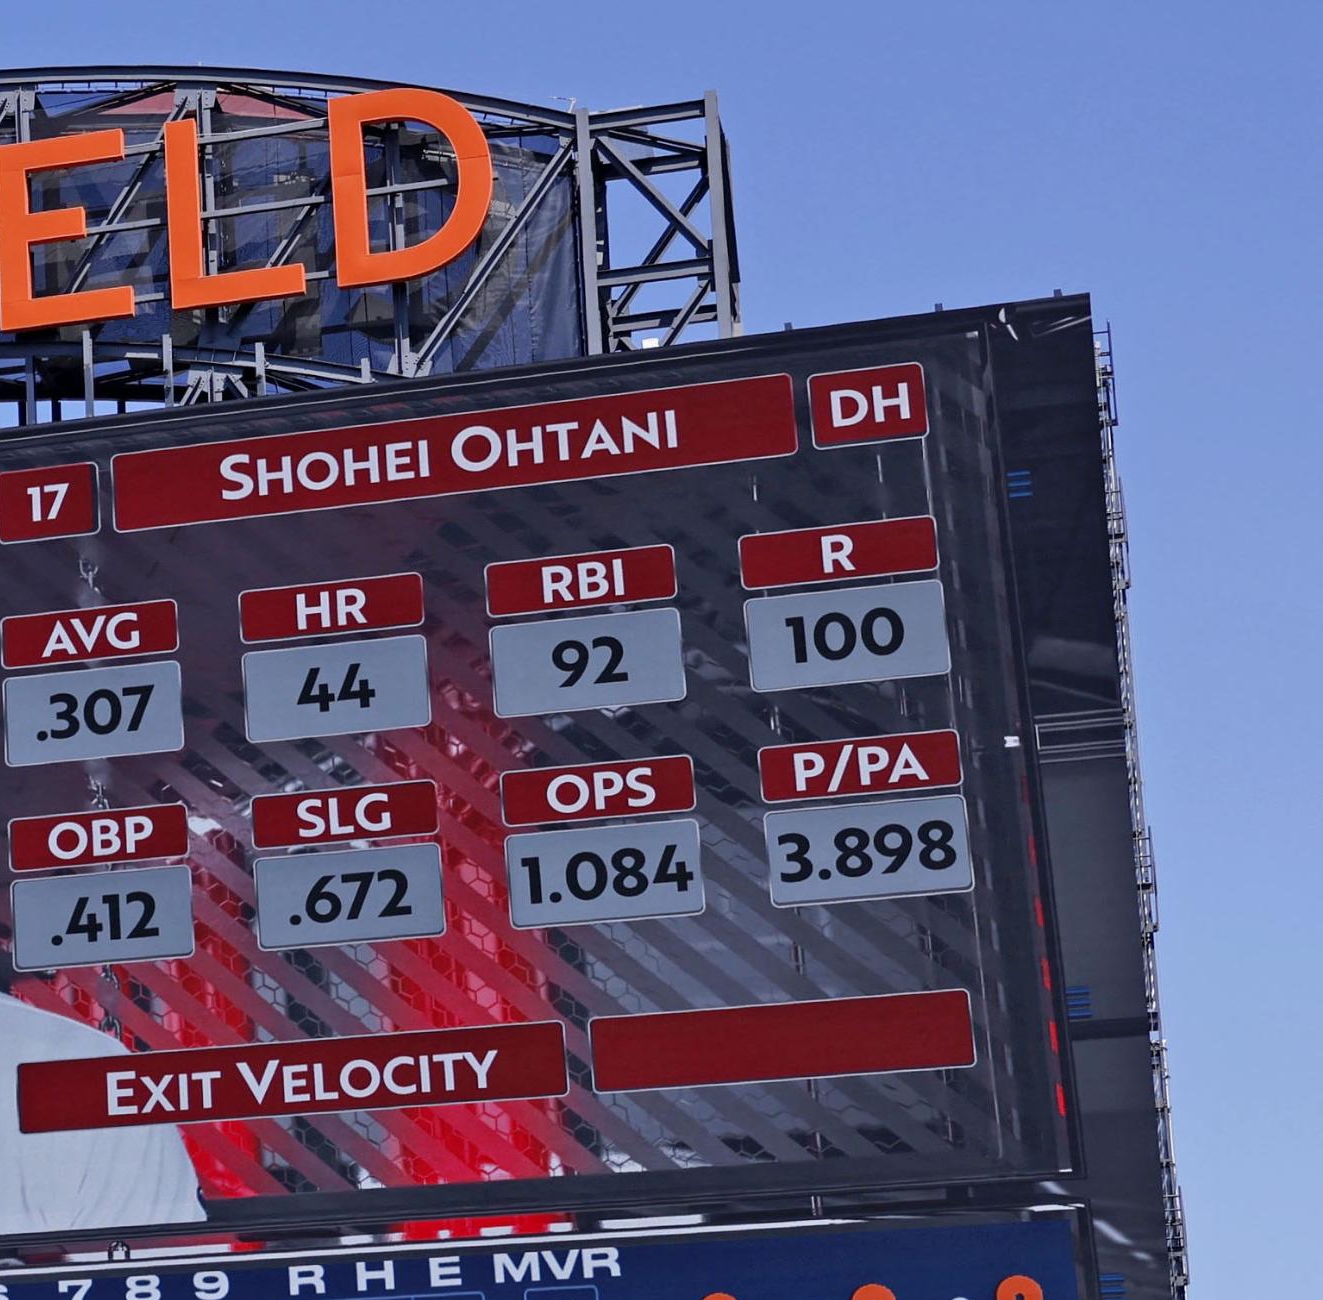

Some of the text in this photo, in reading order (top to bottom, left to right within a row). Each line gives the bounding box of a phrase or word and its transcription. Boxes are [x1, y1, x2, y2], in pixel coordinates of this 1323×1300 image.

[26, 382, 912, 522] 17 SHOHEI OHTANI DH
[41, 534, 855, 657] AVG HR RBI R
[34, 606, 905, 744] .307 44 92 100
[46, 745, 930, 858] OBP SLG OPS P/PA
[49, 818, 958, 946] .412 .672 1.084 3.898
[105, 1047, 499, 1116] EXIT VELOCITY
[288, 1264, 327, 1296] R
[357, 1260, 396, 1292] H
[429, 1256, 463, 1288] E
[494, 1246, 623, 1286] MVR
